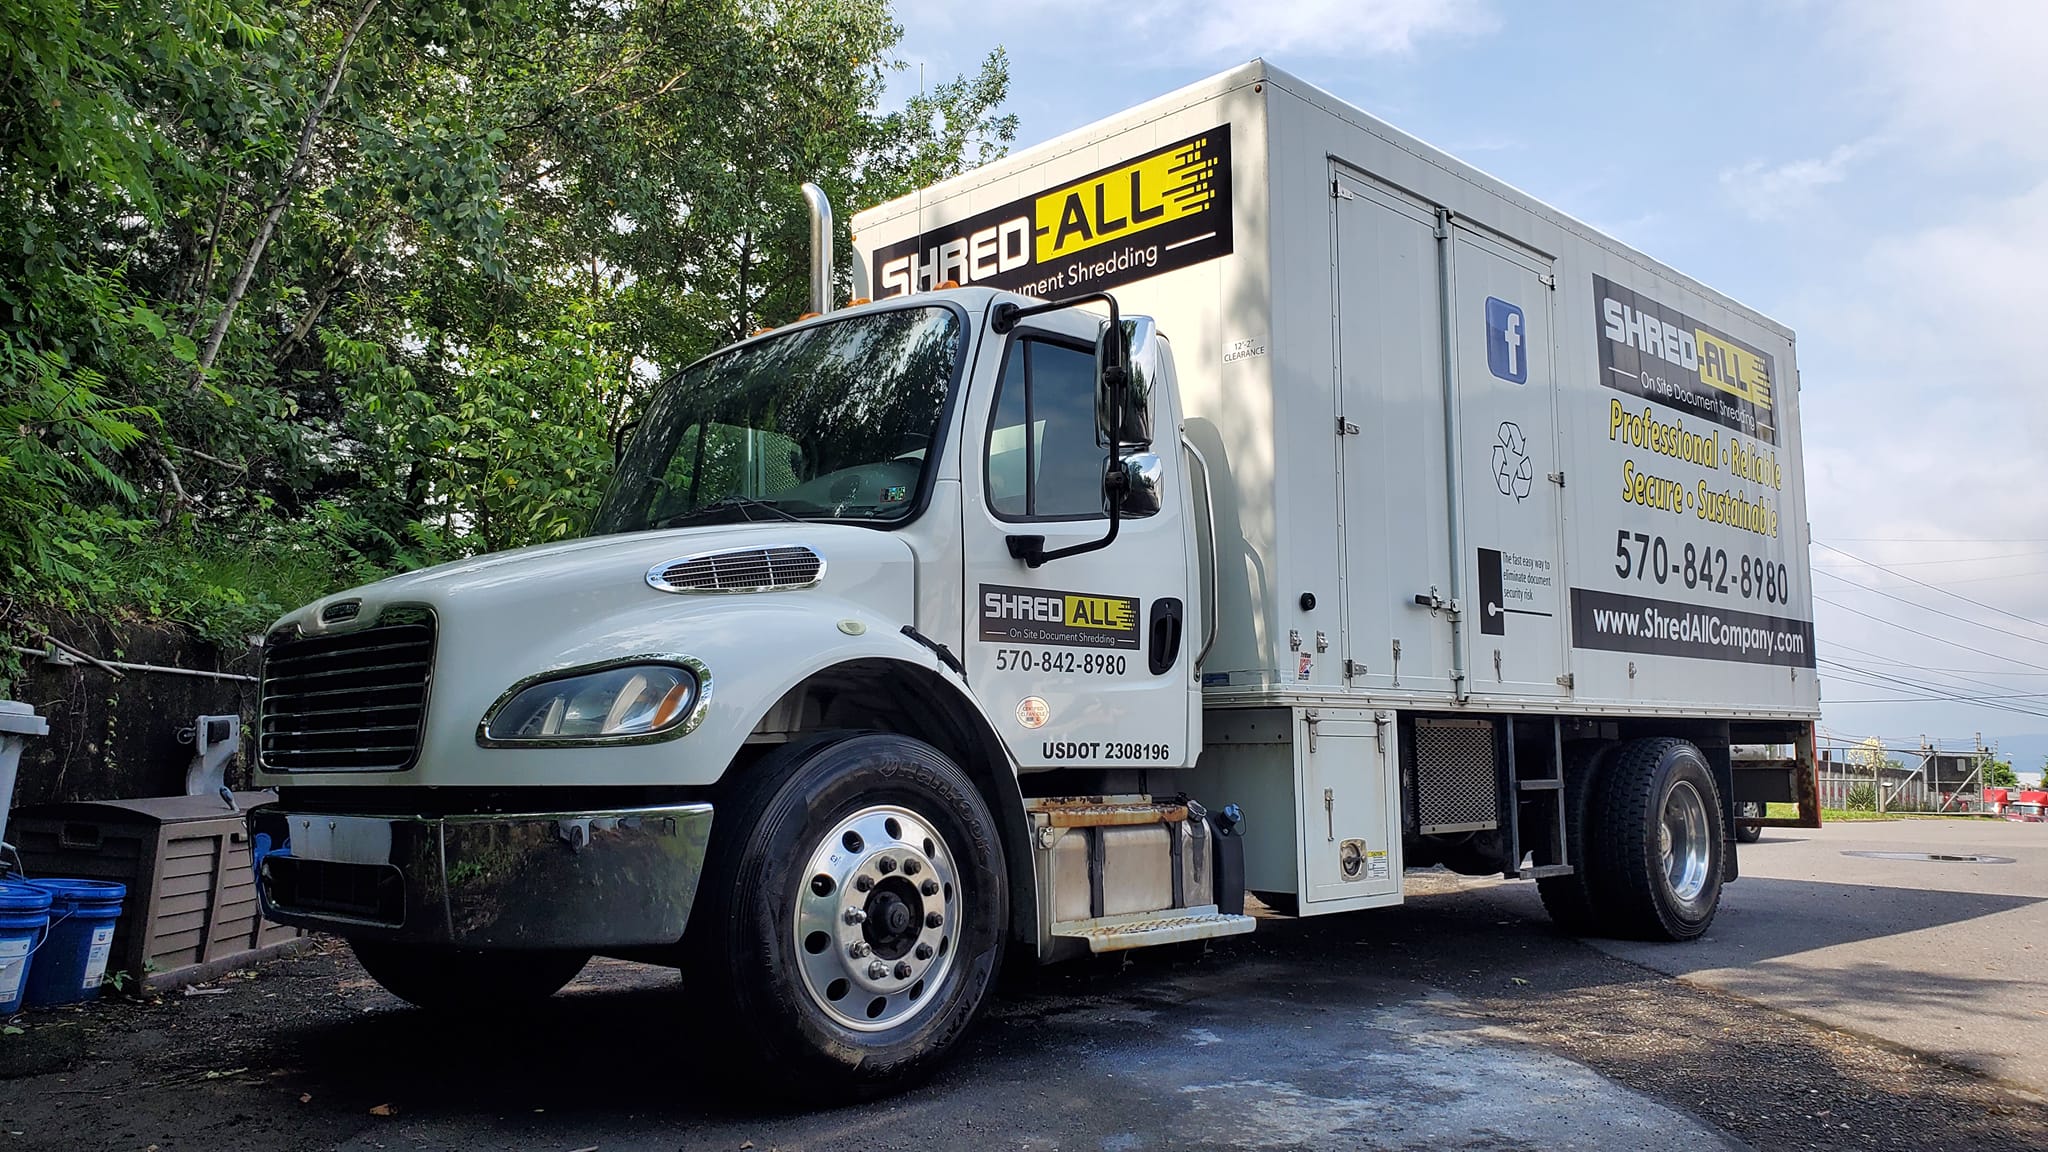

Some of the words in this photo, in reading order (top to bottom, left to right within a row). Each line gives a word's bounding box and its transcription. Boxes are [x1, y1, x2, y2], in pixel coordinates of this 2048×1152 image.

[1009, 271, 1064, 297] ument
[1068, 245, 1158, 287] Shredding
[1224, 346, 1265, 362] CLEARANCE
[1640, 371, 1655, 389] On
[1656, 376, 1673, 397] Site
[1674, 384, 1718, 413] Document
[1719, 400, 1755, 431] Shredding
[1609, 398, 1719, 470] Professional
[1731, 438, 1783, 492] Reliable
[1622, 459, 1683, 515] Secure
[1696, 479, 1778, 539] Sustainable
[1502, 551, 1512, 564] The
[1512, 552, 1522, 566] fast
[1522, 557, 1533, 570] easy
[1534, 560, 1544, 572] way
[1544, 560, 1551, 570] to
[1614, 529, 1788, 605] 570-842-8980
[1503, 569, 1527, 584] eliminate
[1527, 572, 1551, 587] document
[985, 592, 1063, 623] SHRED
[1072, 599, 1118, 626] ALL
[1503, 587, 1524, 602] security
[1523, 588, 1534, 601] risk
[1009, 627, 1022, 638] On
[1023, 628, 1038, 640] Site
[1039, 629, 1078, 642] Document
[1078, 632, 1115, 646] Shredding
[1593, 606, 1804, 657] www.ShredAllCompany.com
[996, 649, 1126, 676] 570-842-8980
[1042, 742, 1101, 759] USDOT
[1104, 742, 1170, 760] 2308196
